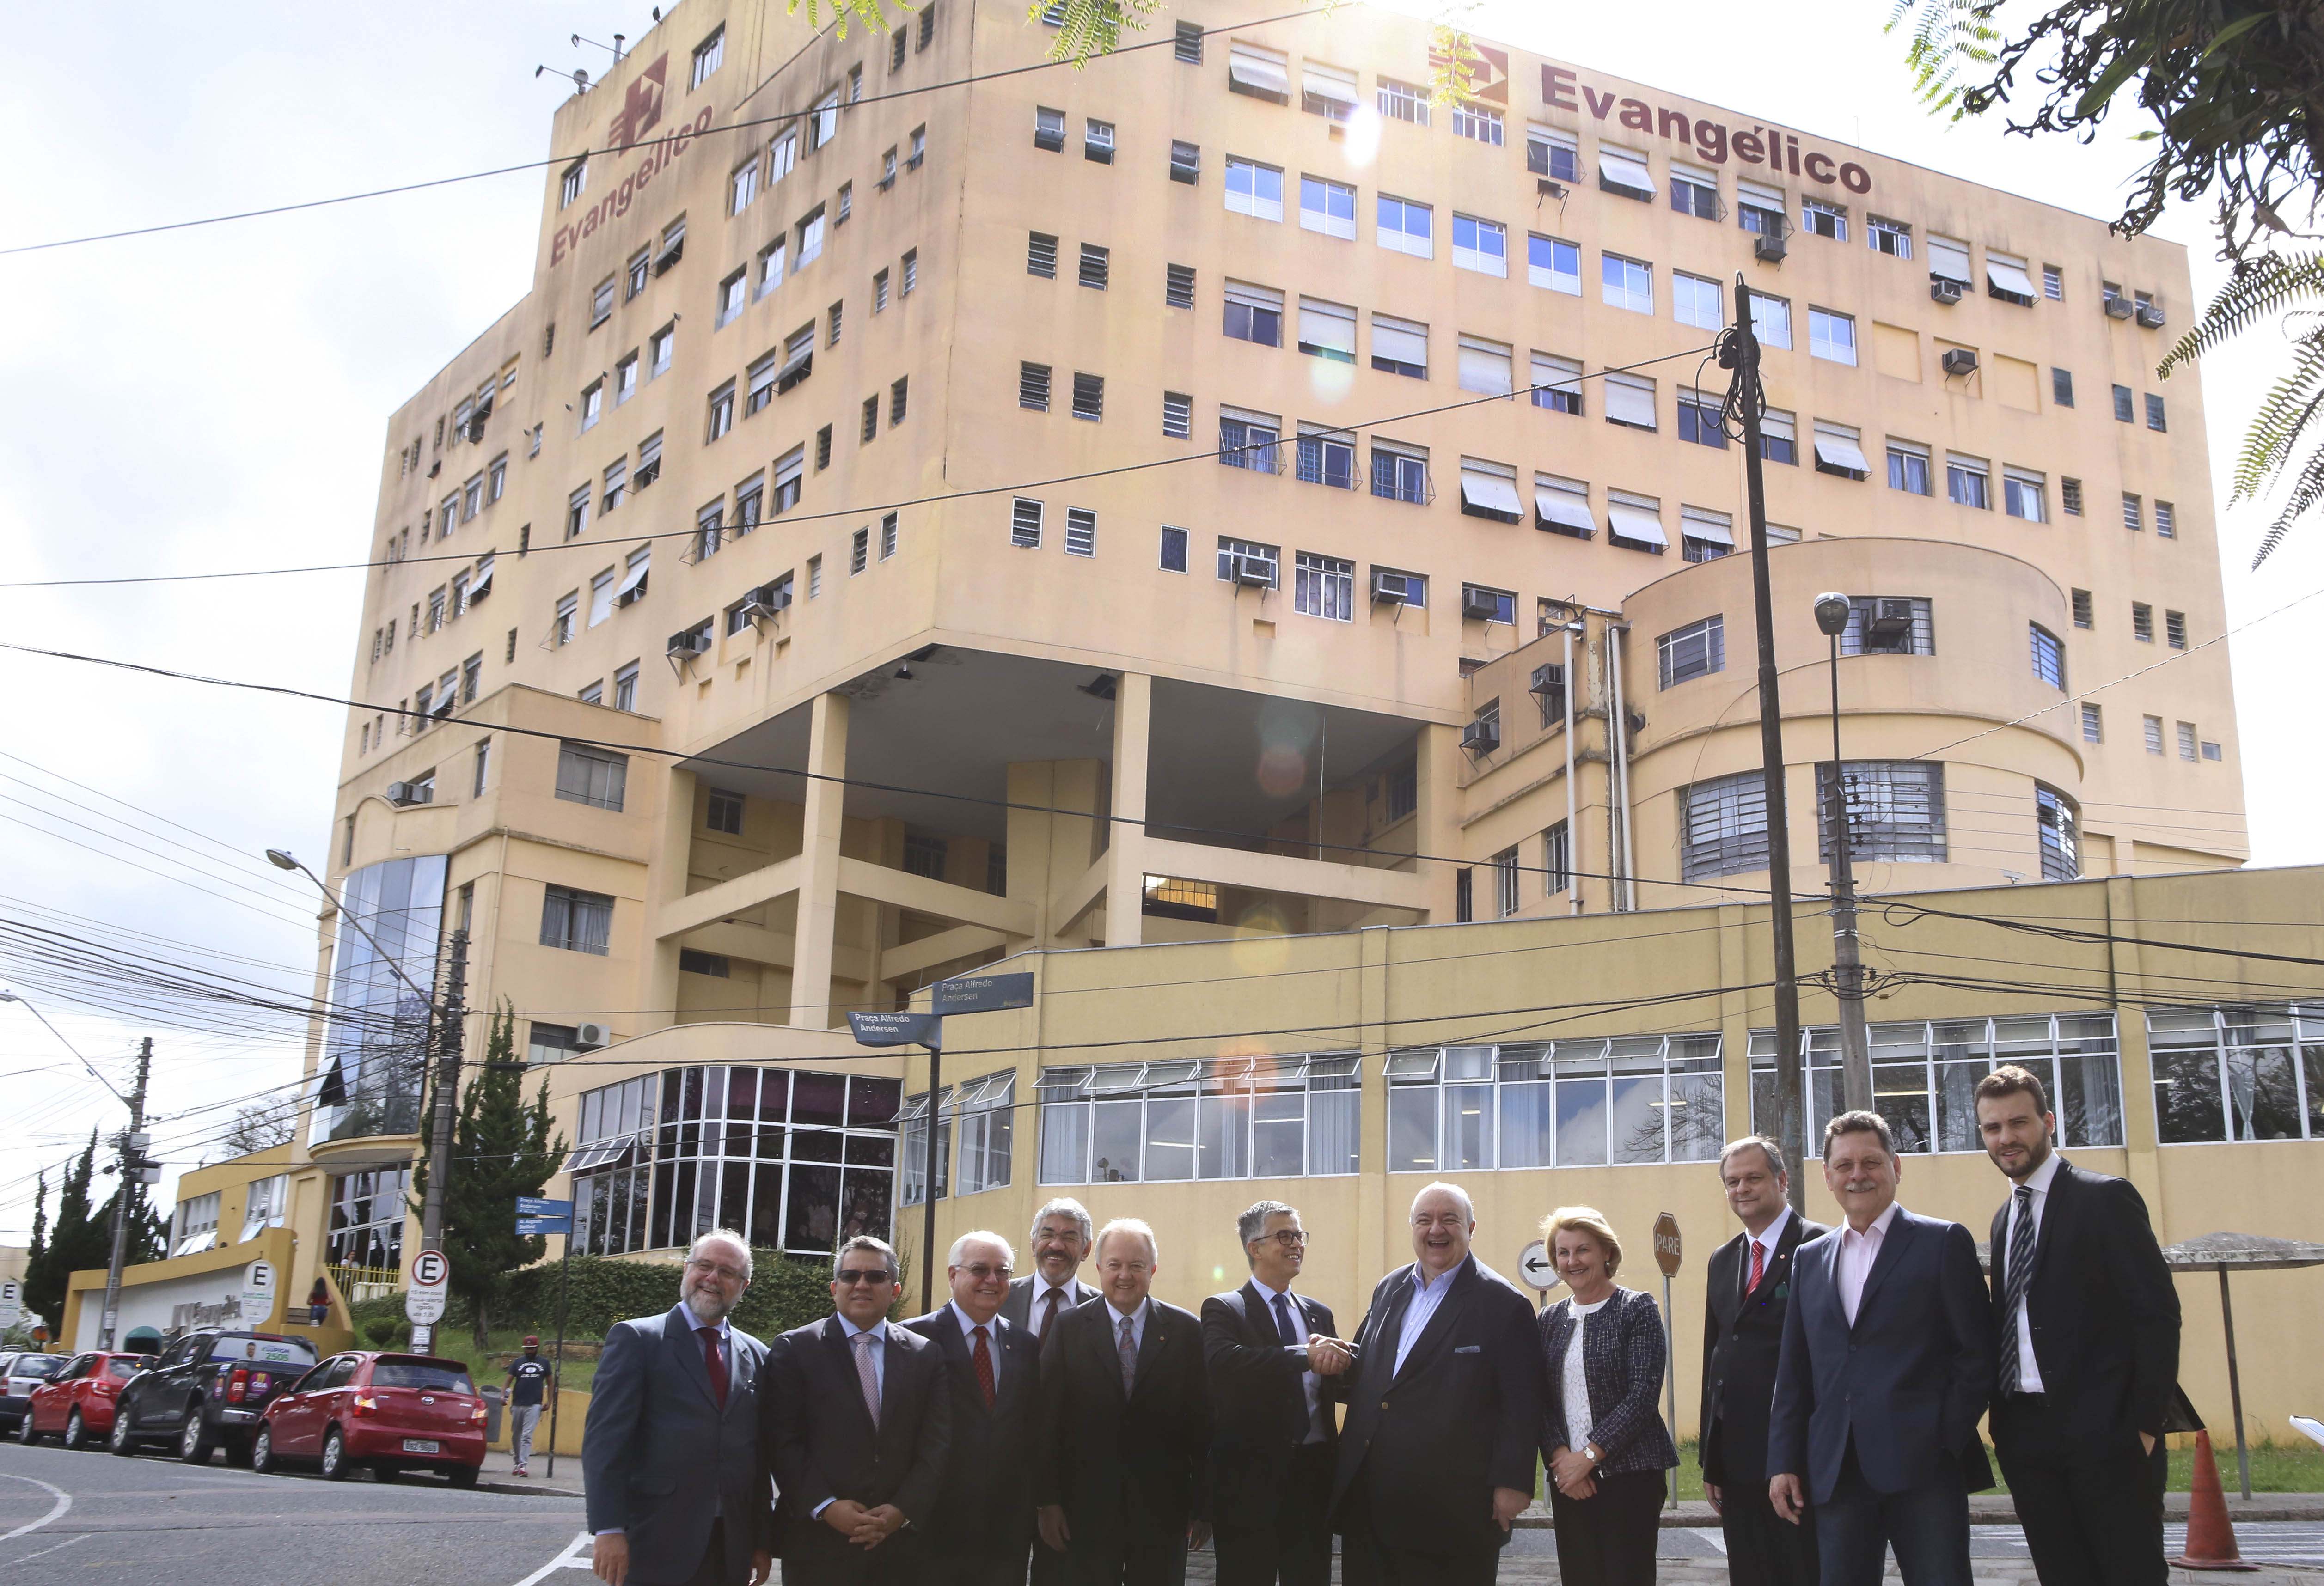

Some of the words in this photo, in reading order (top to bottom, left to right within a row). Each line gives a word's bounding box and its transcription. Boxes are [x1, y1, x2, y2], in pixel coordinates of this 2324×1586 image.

[1541, 63, 1872, 195] Evangélico
[550, 105, 713, 268] Evangélico
[942, 982, 963, 992] Praça
[965, 979, 993, 989] Alfredo
[942, 992, 978, 1002] Andersen
[855, 1013, 879, 1024] Praça
[881, 1014, 910, 1023] Alfredo
[860, 1024, 899, 1033] Andersen
[1656, 1233, 1679, 1256] PARE
[254, 1266, 268, 1285] E
[421, 1257, 439, 1280] E
[3, 1284, 15, 1299] E
